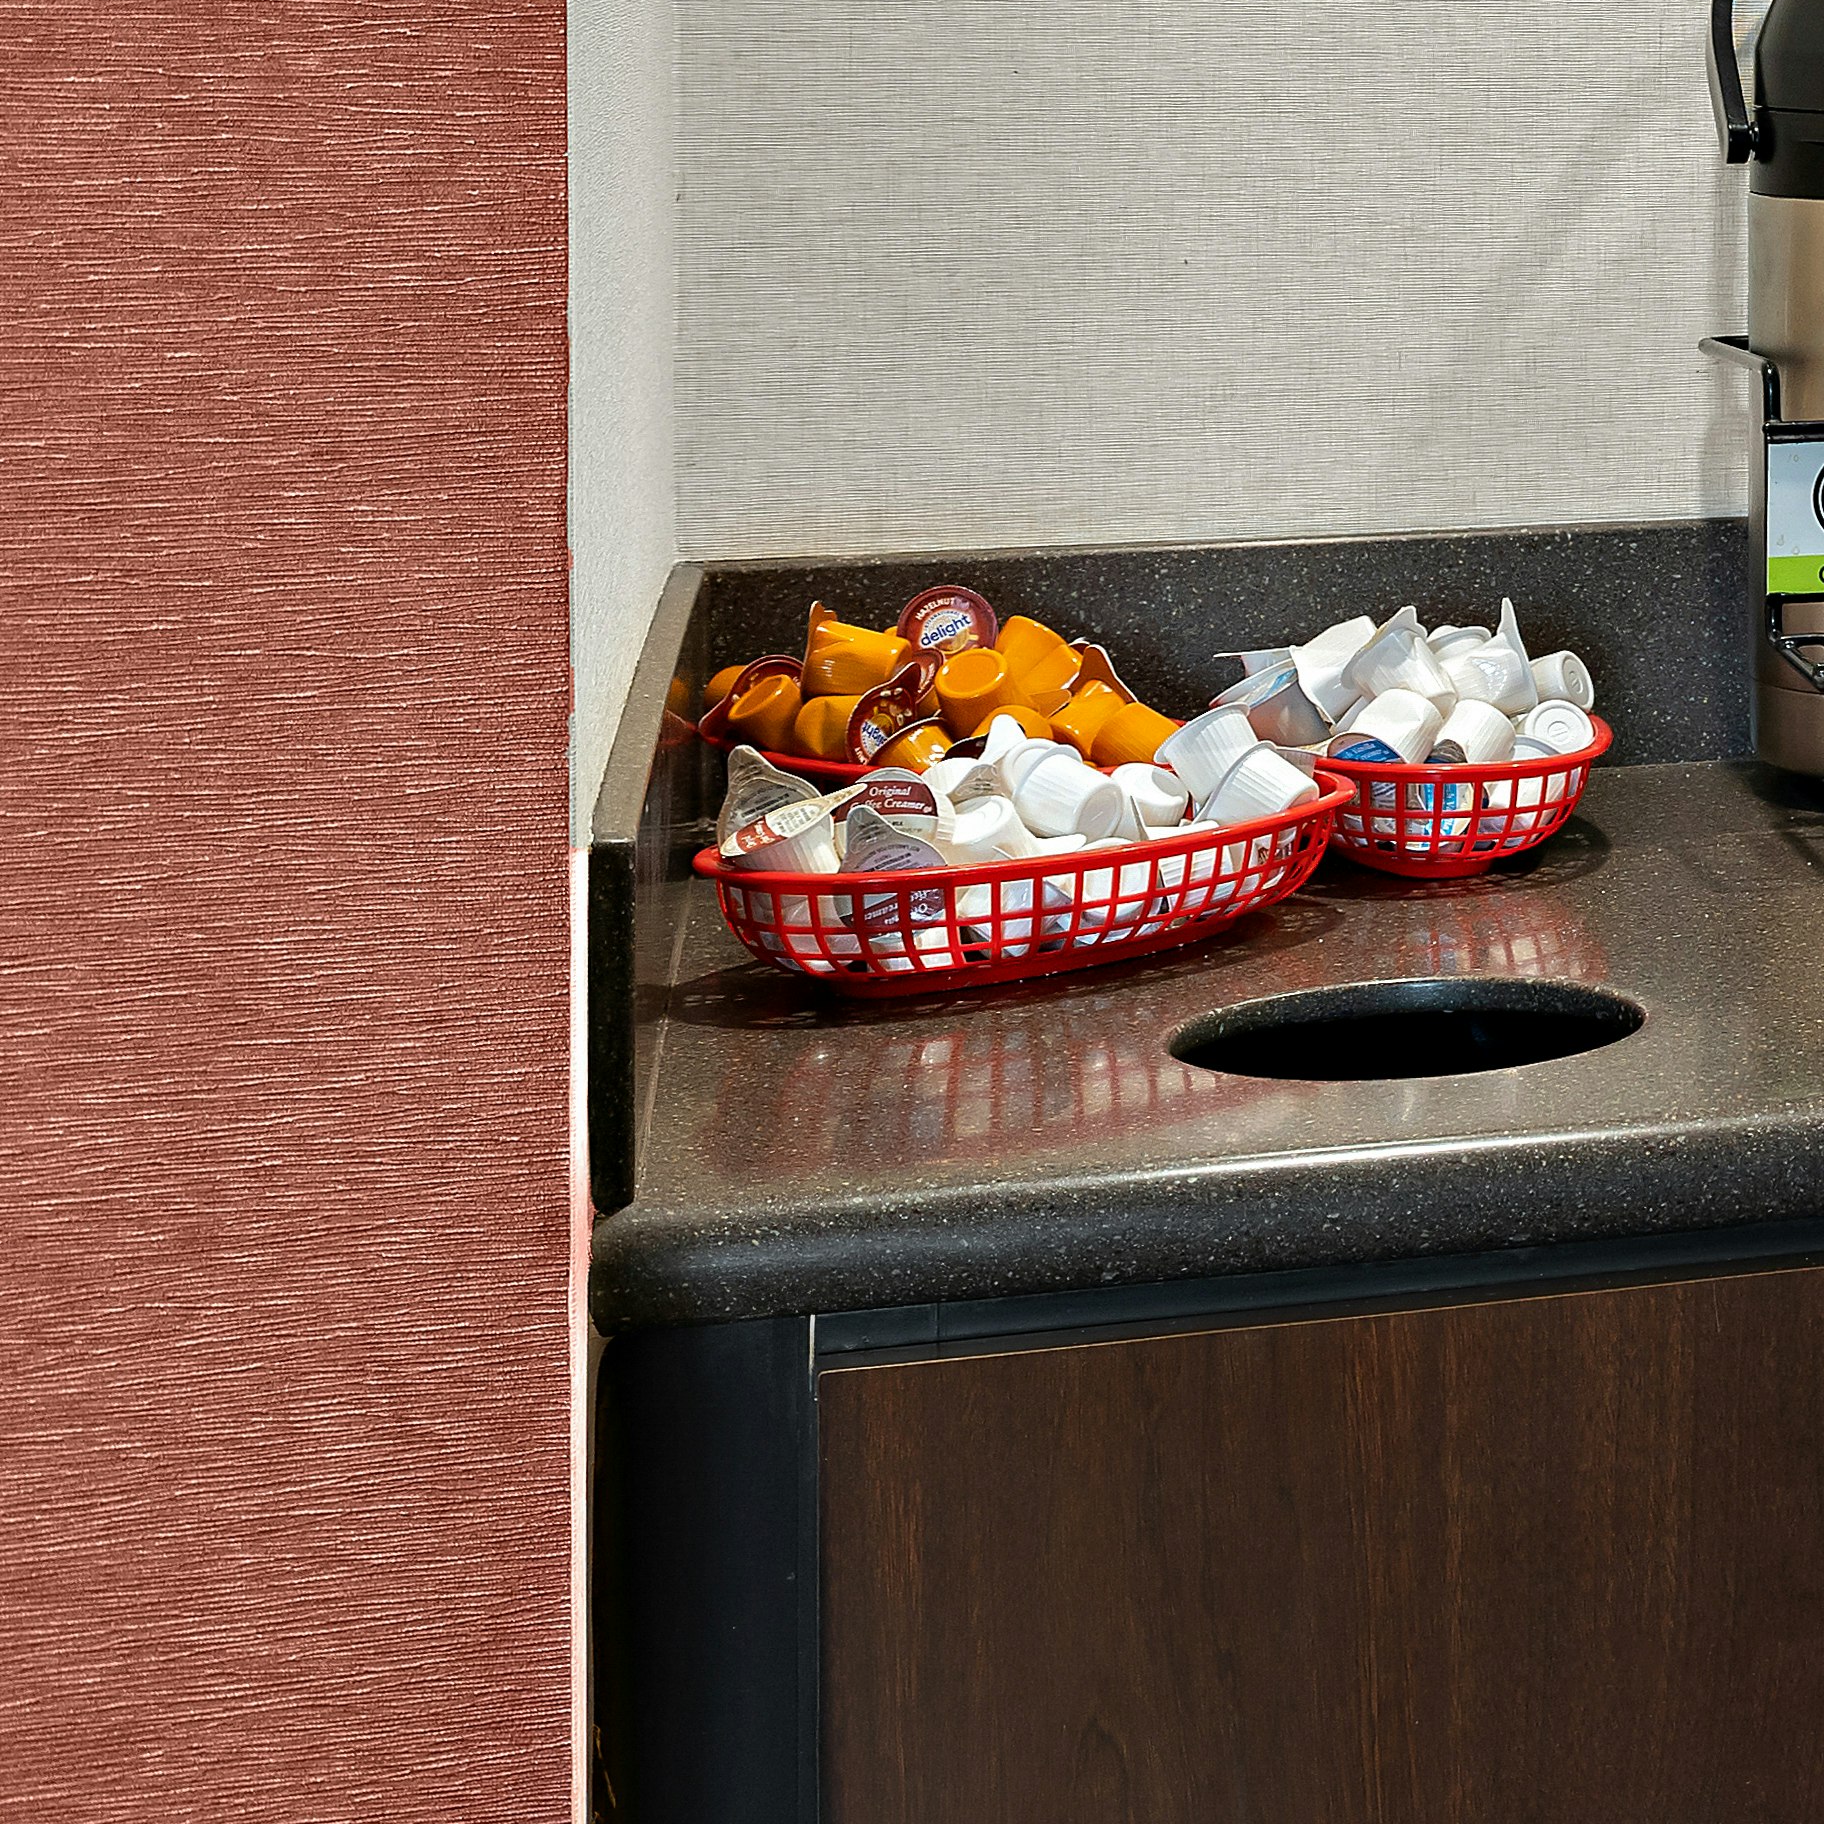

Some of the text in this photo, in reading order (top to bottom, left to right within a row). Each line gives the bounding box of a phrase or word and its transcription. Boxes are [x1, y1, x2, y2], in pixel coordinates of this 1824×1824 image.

[915, 597, 955, 621] HAZELNUT
[921, 614, 971, 647] delight
[869, 785, 912, 798] Original
[884, 798, 925, 810] Creamer
